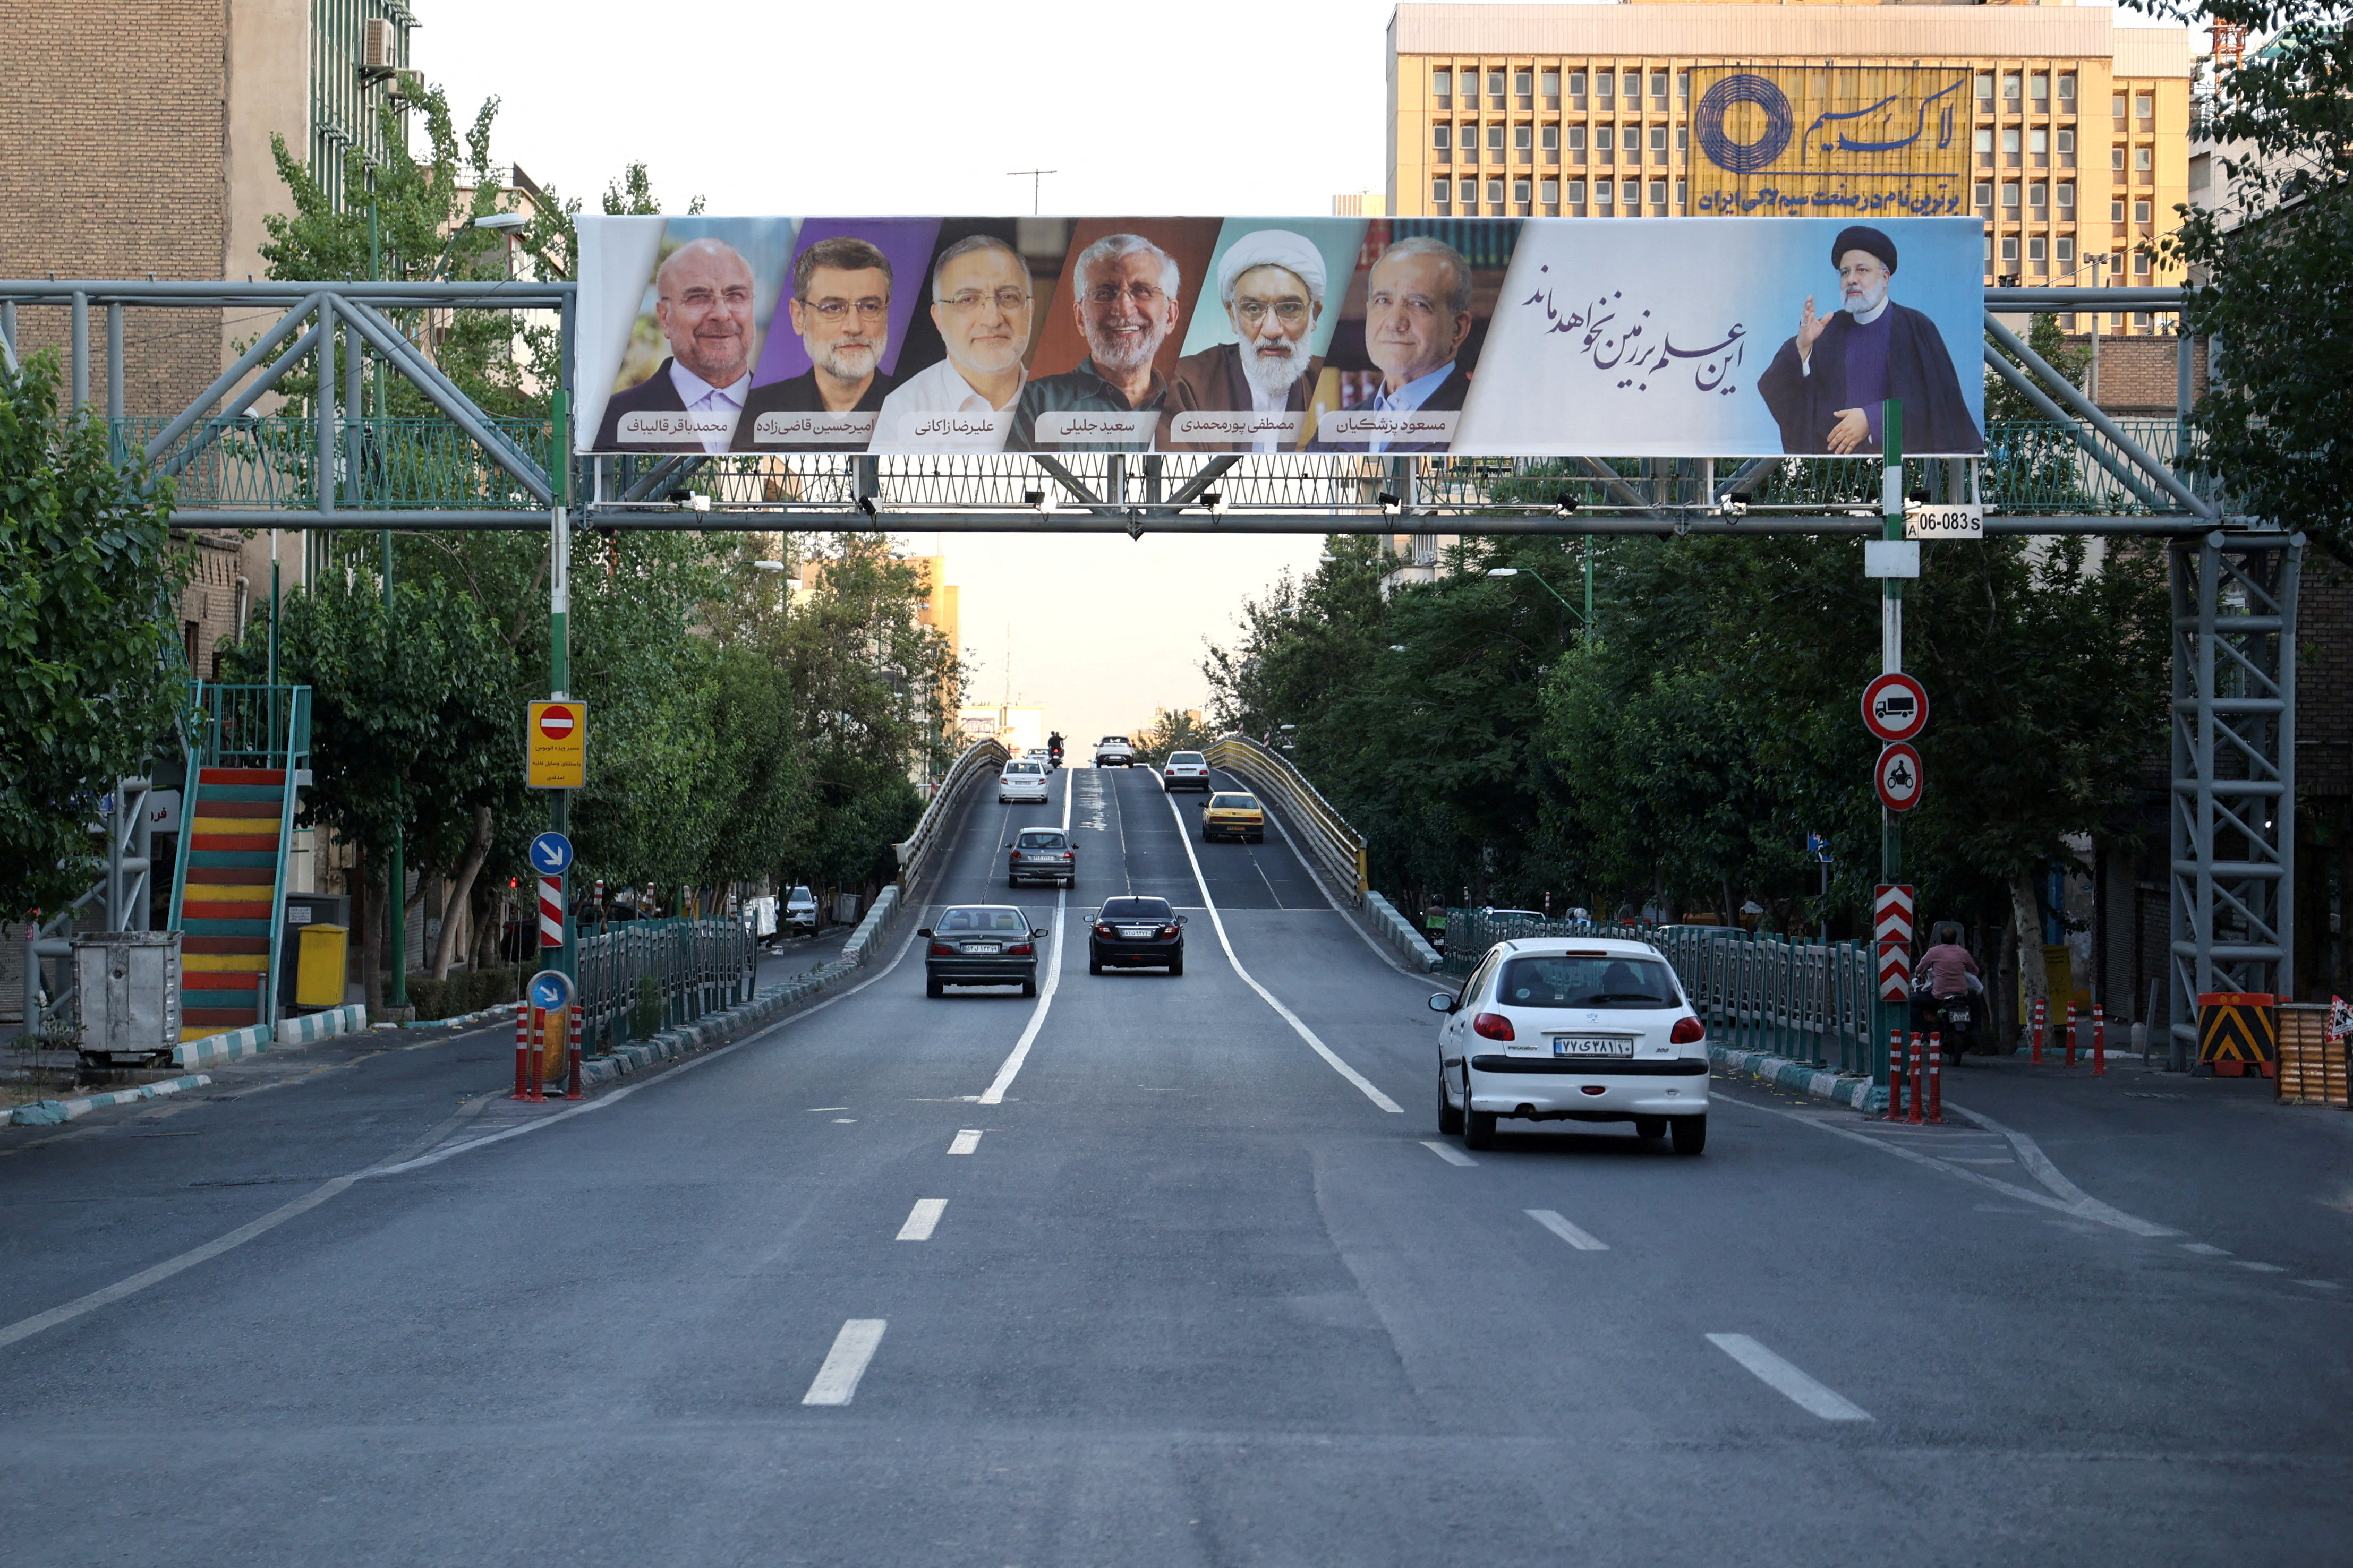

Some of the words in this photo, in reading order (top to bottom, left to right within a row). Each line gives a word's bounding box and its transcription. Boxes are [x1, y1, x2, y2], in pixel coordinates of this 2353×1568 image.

[1699, 189, 1740, 215] ایران
[1743, 188, 1779, 211] لاکی
[1779, 192, 1809, 215] سیم
[1812, 183, 1860, 207] صنعت
[1857, 192, 1883, 211] در
[1884, 184, 1911, 210] نام
[1911, 184, 1960, 216] برترین
[1522, 264, 1557, 320] ماند
[1545, 290, 1622, 354] نخواهد
[1593, 310, 1651, 389] زمین
[1649, 322, 1747, 376] علم
[1633, 344, 1656, 392] بر
[1695, 340, 1744, 395] این
[627, 418, 669, 435] قالیباف
[669, 418, 728, 435] محمدباقر
[813, 419, 874, 434] امیرحسین
[915, 419, 951, 435] زاکانی
[952, 419, 994, 435] علیرضا
[1060, 419, 1097, 435] جلیلی
[1099, 422, 1135, 434] سعید
[1181, 423, 1246, 437] پورمحمدی
[1248, 421, 1294, 435] مصطفی
[1336, 417, 1398, 435] پزشکیان
[1400, 421, 1446, 434] مسعود
[1920, 512, 1968, 530] 06-083
[1908, 525, 1917, 536] A
